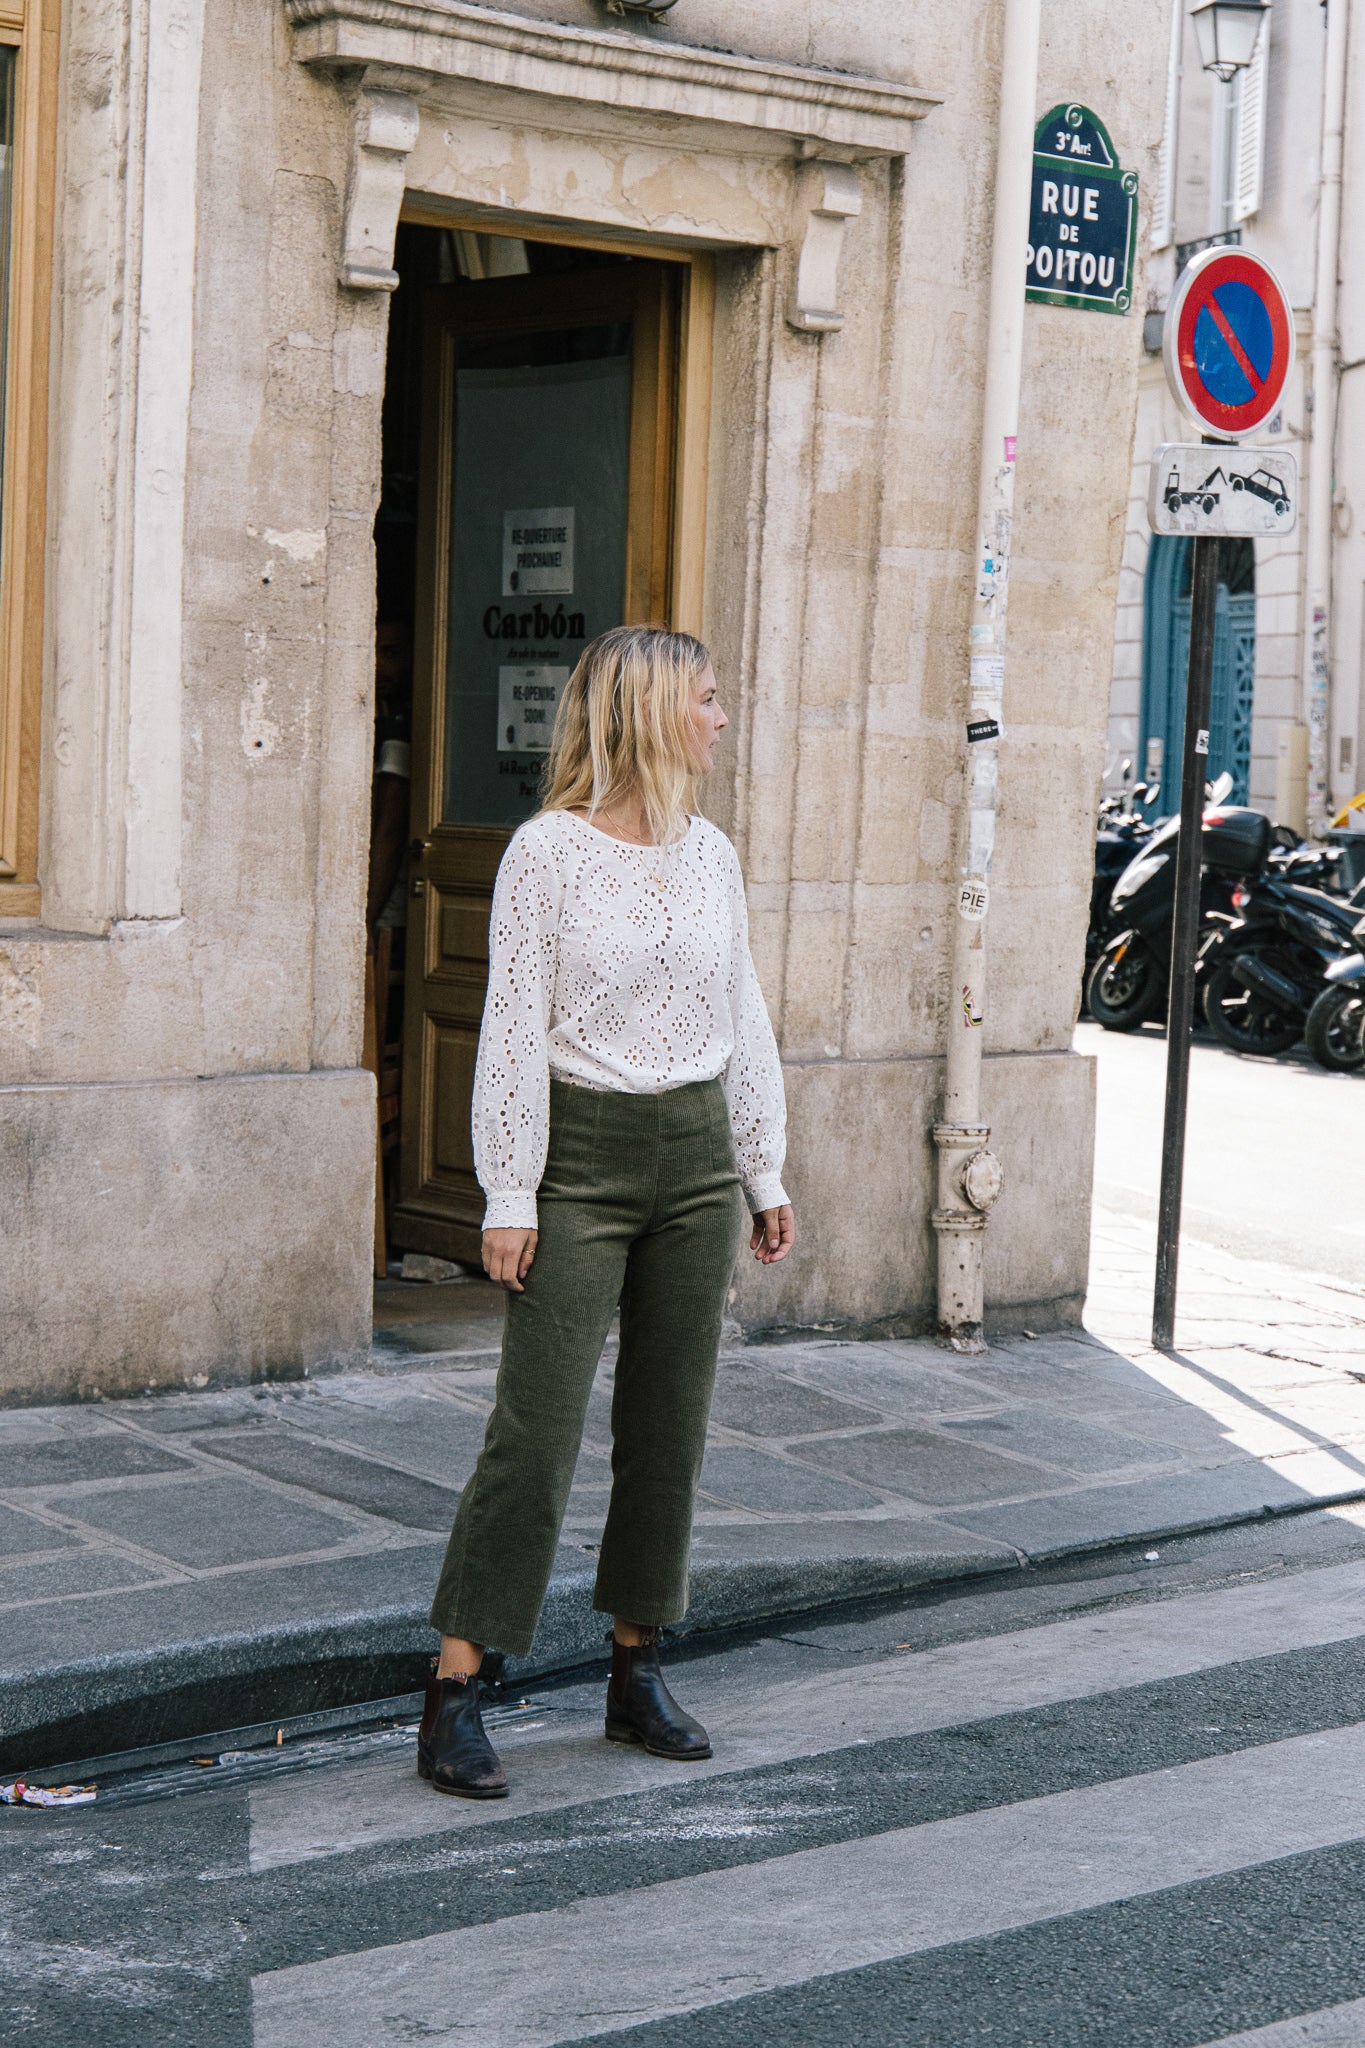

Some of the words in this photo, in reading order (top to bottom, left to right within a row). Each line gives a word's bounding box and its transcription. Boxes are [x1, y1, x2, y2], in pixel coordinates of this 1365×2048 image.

[1041, 180, 1100, 221] RUE
[1059, 223, 1080, 243] DE
[512, 527, 567, 545] RE-OUVERTURE
[483, 602, 586, 639] Carbón
[513, 685, 555, 701] RE-OPENING
[511, 760, 528, 775] Rue
[961, 891, 985, 908] PIE
[959, 905, 983, 915] STORE
